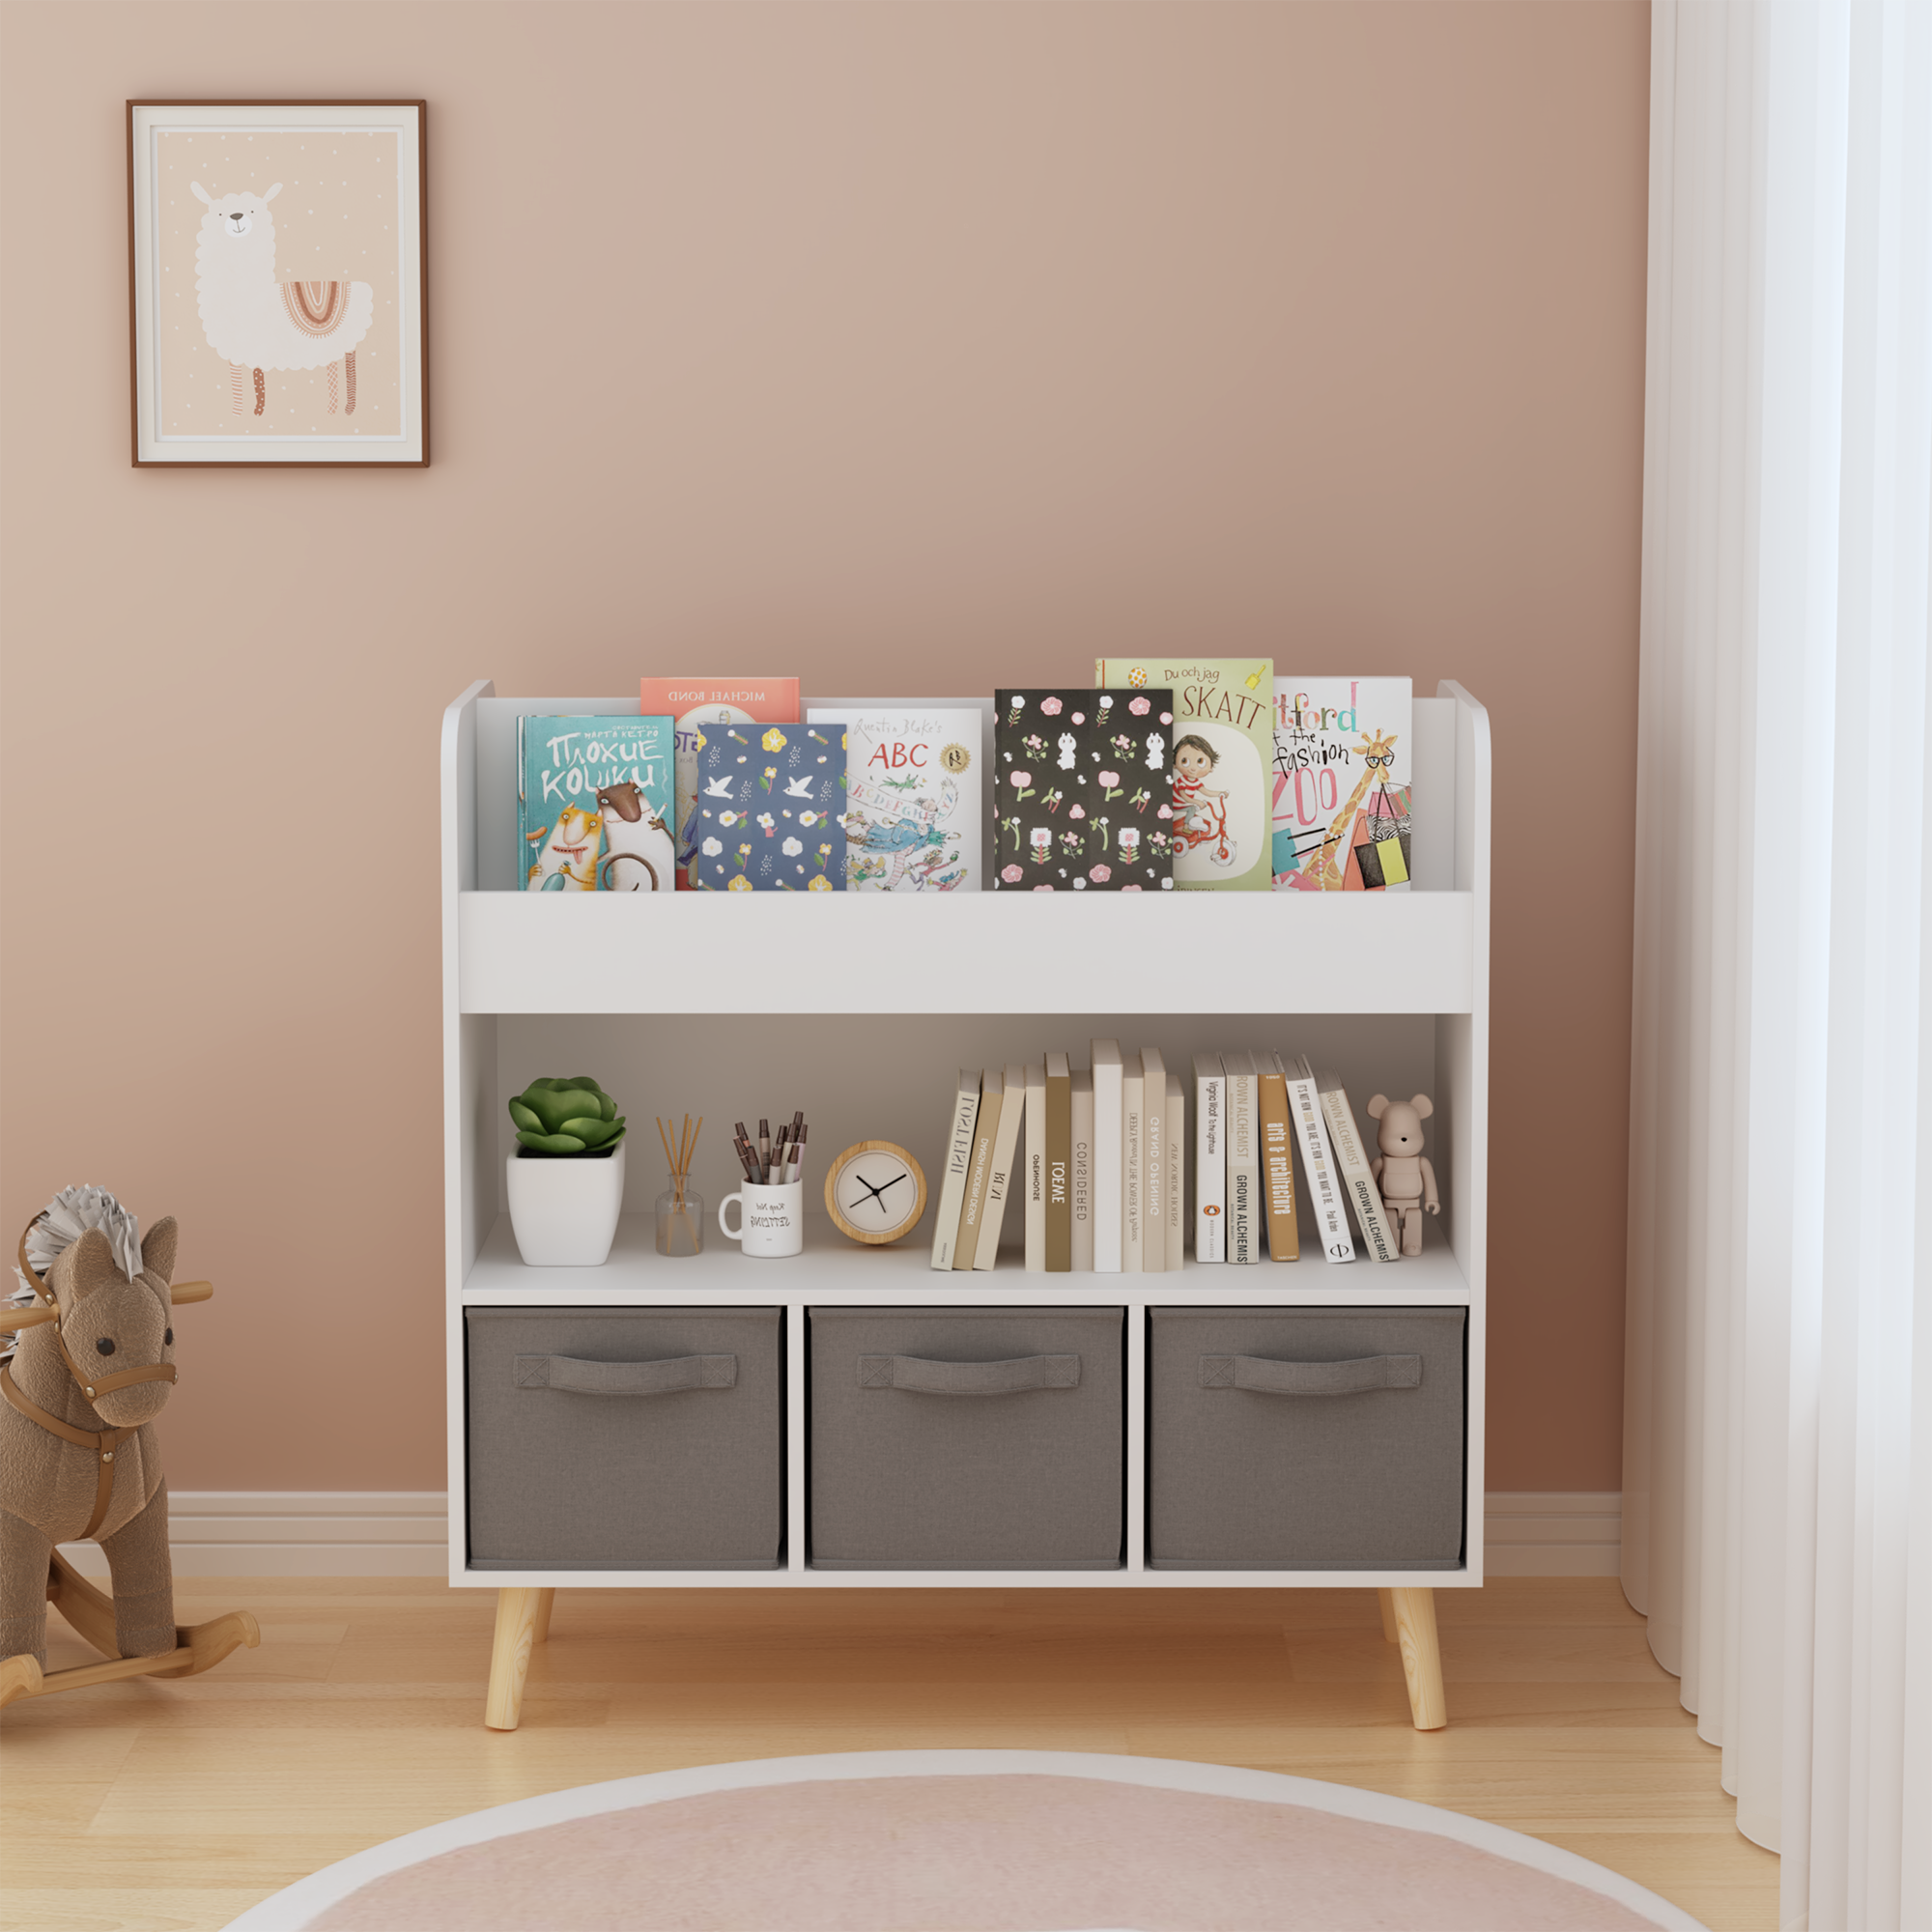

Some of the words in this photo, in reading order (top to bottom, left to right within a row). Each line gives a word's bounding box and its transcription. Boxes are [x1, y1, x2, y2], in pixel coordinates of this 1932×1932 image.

[1164, 669, 1179, 681] Du
[1181, 667, 1200, 677] och
[1197, 667, 1220, 684] jag
[1181, 685, 1266, 729] SKATT
[1272, 681, 1360, 732] itford
[583, 730, 618, 739] МАРТА
[621, 729, 659, 738] КЕТРО
[854, 717, 897, 744] Quentin
[896, 719, 943, 737] Blake's
[1290, 729, 1316, 746] the
[867, 742, 929, 770] ABC
[1272, 739, 1350, 780] fashion
[1272, 767, 1338, 826] ZOO
[1206, 1081, 1218, 1101] Virginia
[1236, 1076, 1249, 1104] ROWN
[1299, 1094, 1310, 1102] NOT
[1208, 1101, 1218, 1118] Woolf
[1301, 1102, 1312, 1111] HOW
[1236, 1107, 1249, 1158] ALCHEMIST
[1266, 1122, 1287, 1142] arts
[1306, 1122, 1317, 1131] YOU
[1326, 1092, 1341, 1119] ROWN
[1335, 1121, 1360, 1166] ALCHEMIST
[1313, 1151, 1323, 1159] HOW
[1317, 1171, 1328, 1179] YOU
[1236, 1175, 1248, 1211] GROWN
[1269, 1156, 1292, 1215] architecture
[1320, 1180, 1331, 1192] WANT
[1355, 1180, 1375, 1214] GROWN
[1326, 1210, 1336, 1220] Paul
[1327, 1220, 1339, 1232] Arden
